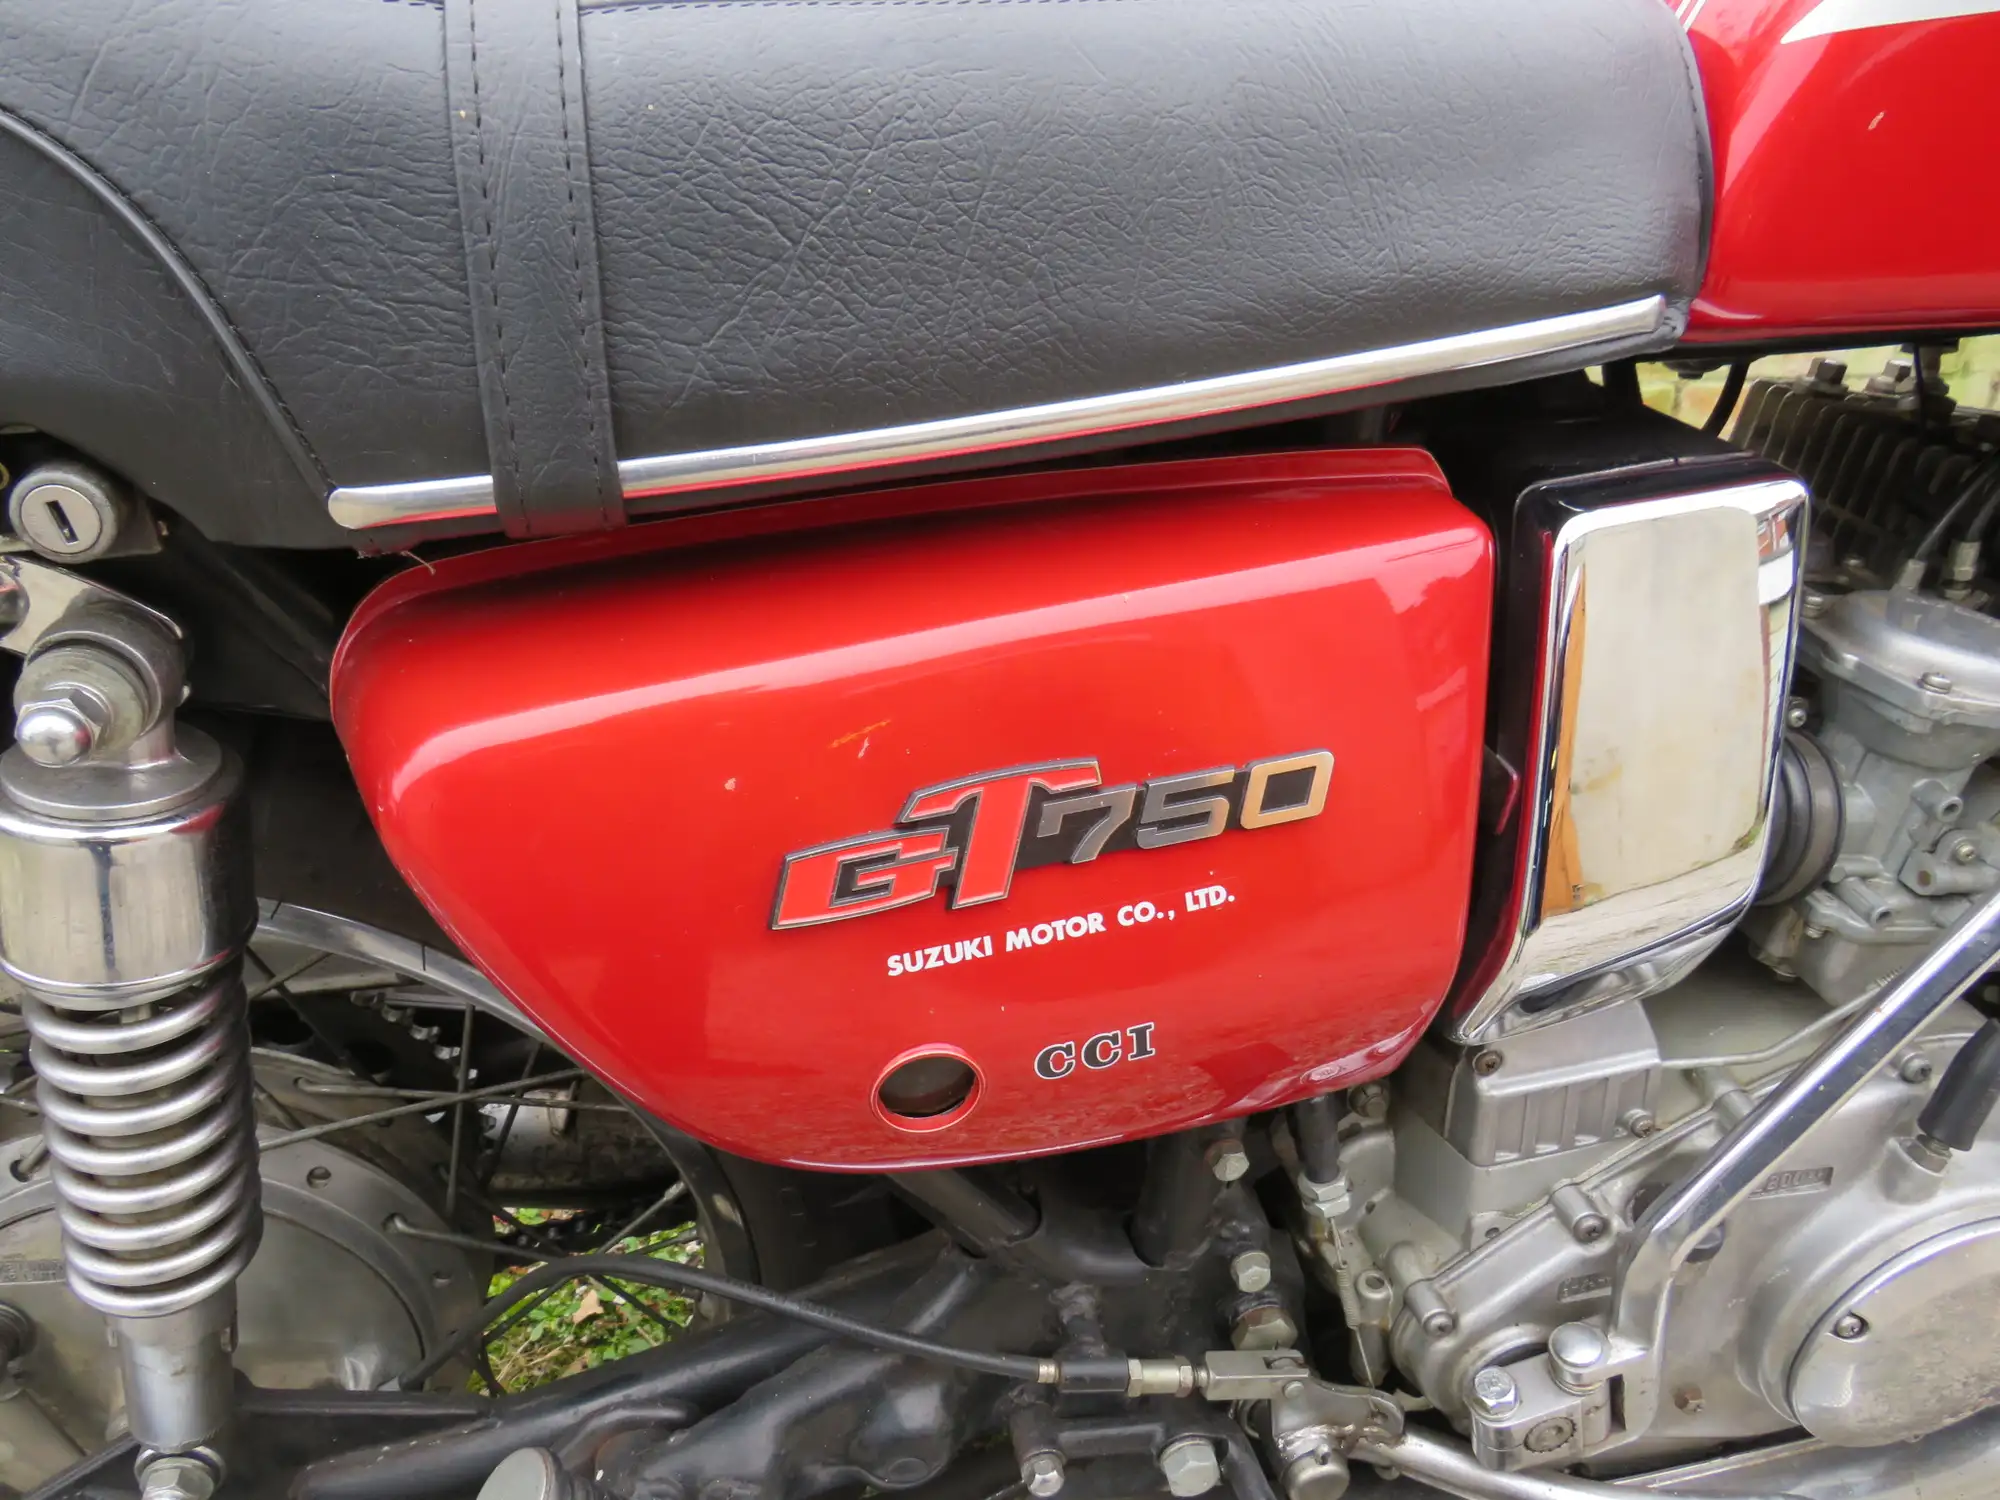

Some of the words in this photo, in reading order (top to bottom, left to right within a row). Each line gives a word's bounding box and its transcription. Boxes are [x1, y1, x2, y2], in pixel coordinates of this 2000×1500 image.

[886, 935, 993, 977] SUZUKI
[1005, 911, 1107, 953] MOTOR
[1116, 900, 1177, 928] CO.,
[1184, 884, 1236, 913] LTD.
[1033, 1021, 1156, 1080] CCI
